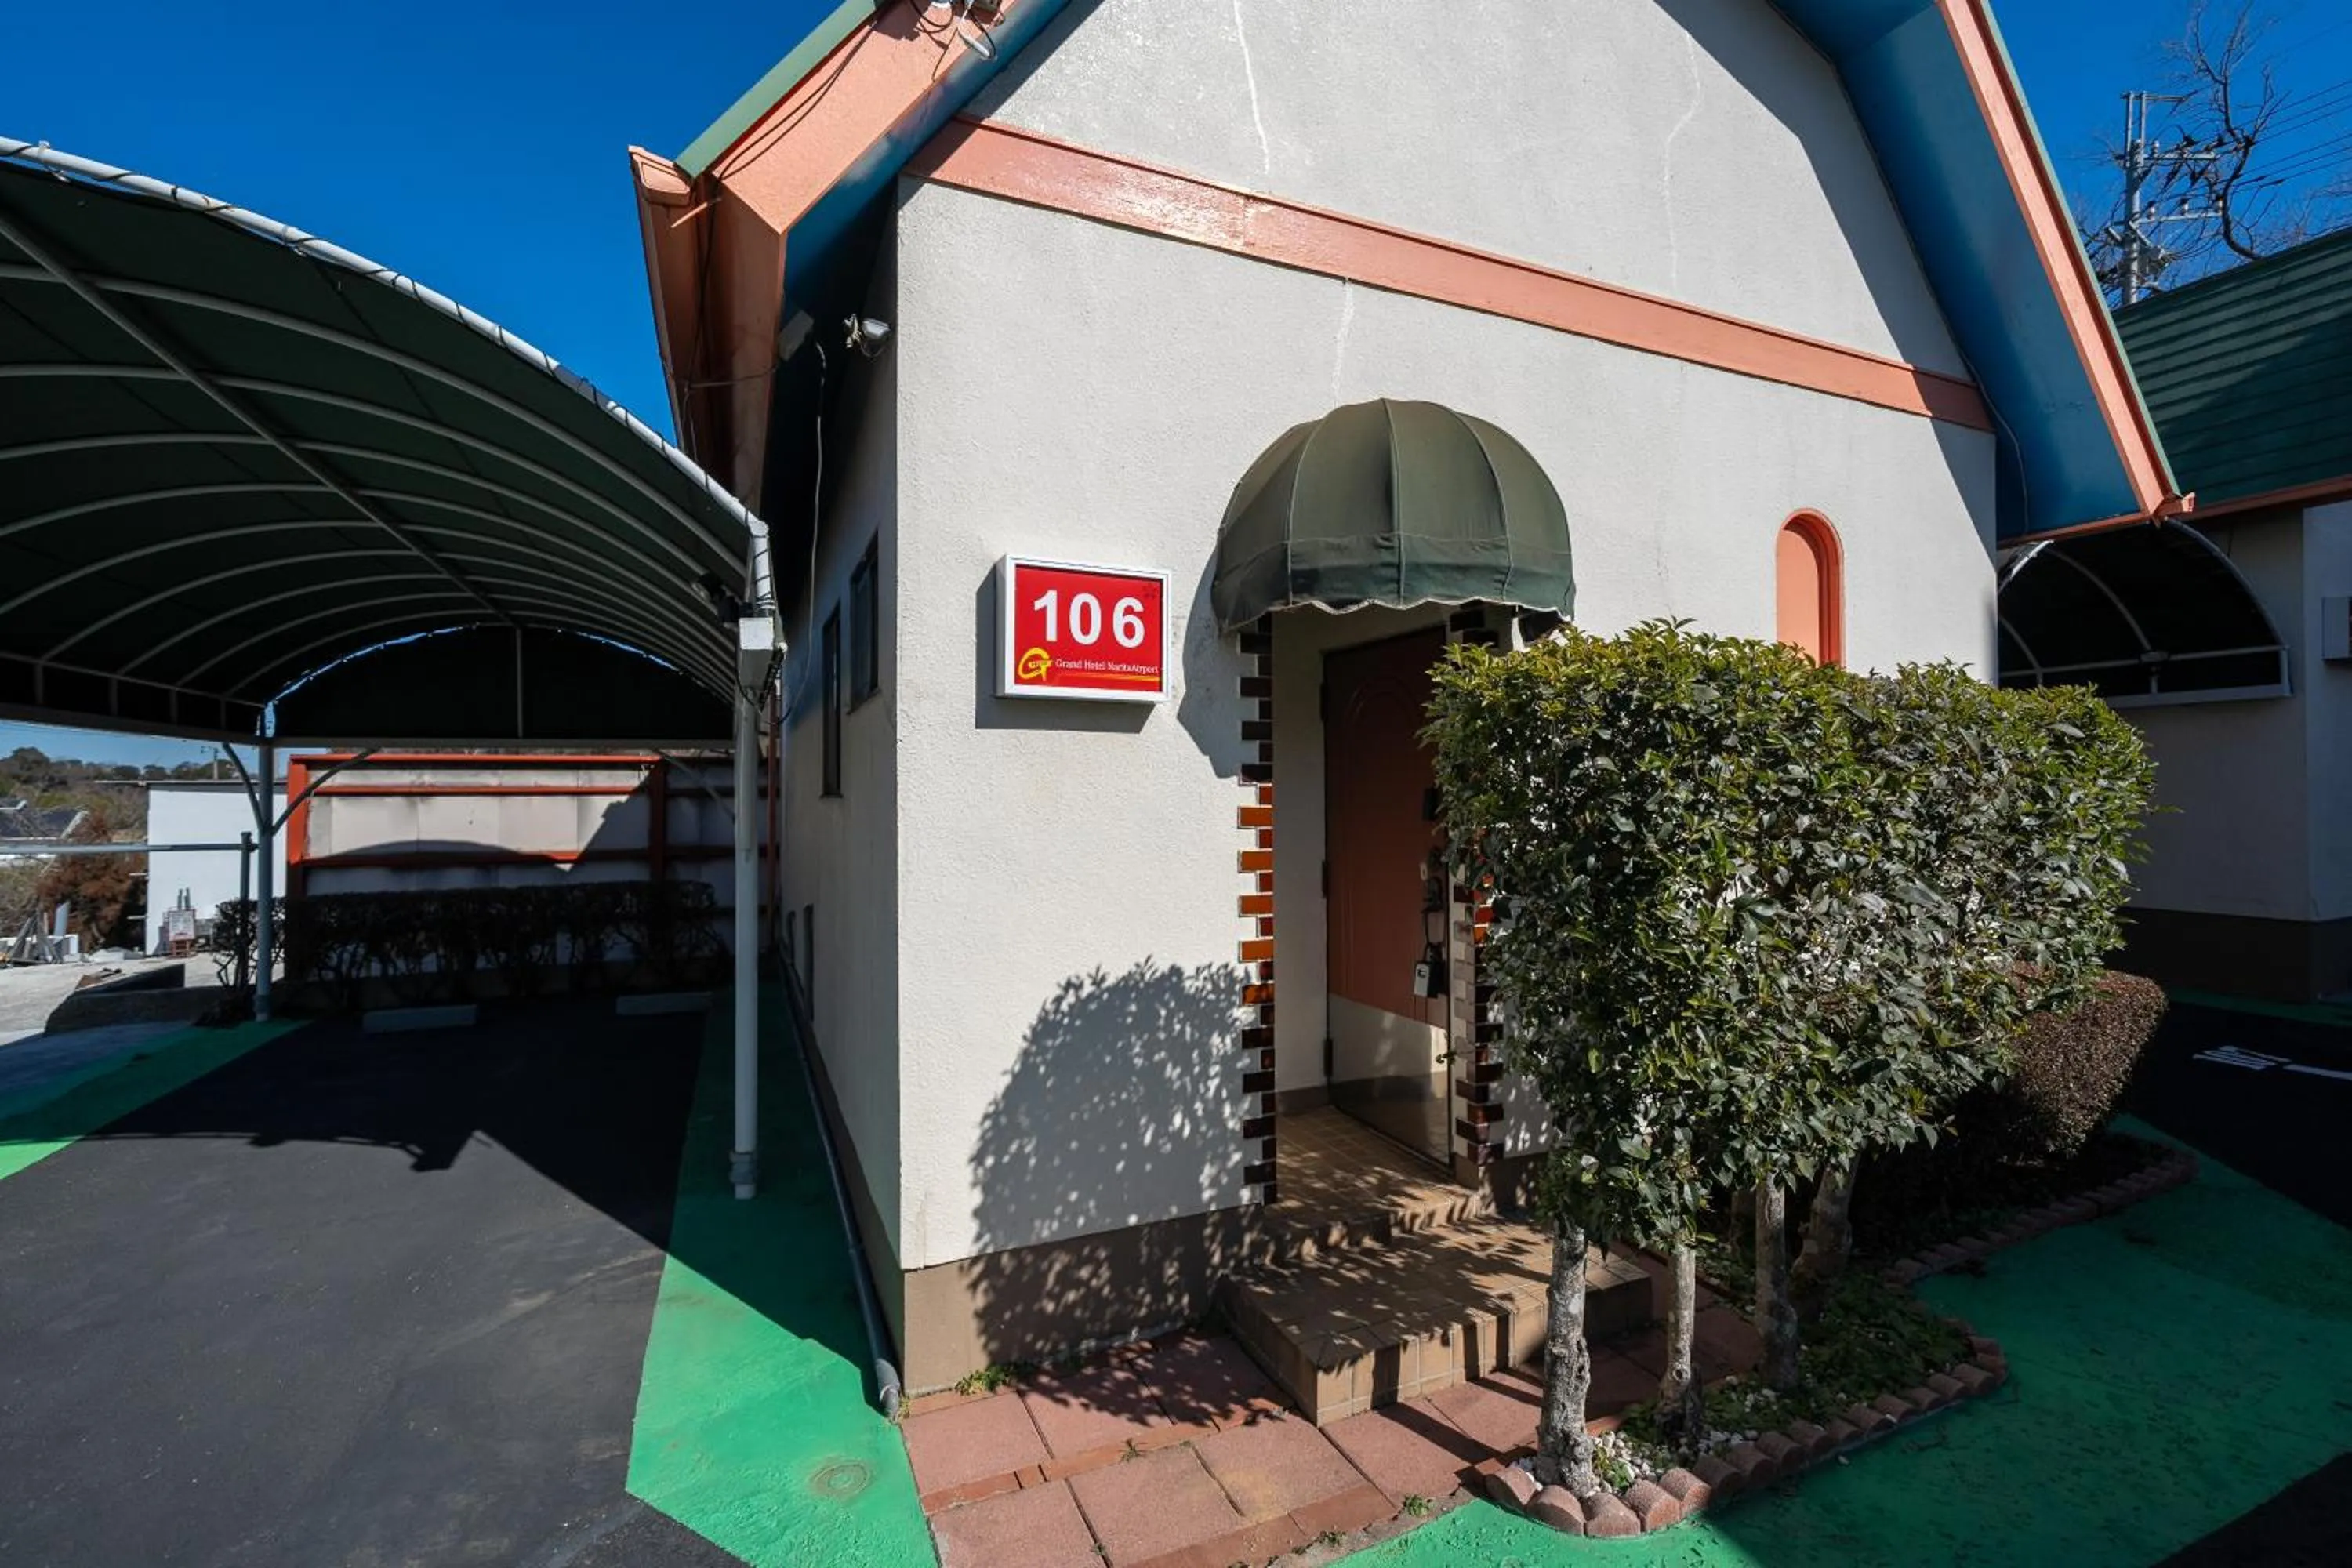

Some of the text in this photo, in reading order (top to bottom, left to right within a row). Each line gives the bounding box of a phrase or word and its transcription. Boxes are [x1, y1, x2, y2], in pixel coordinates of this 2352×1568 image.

[1034, 589, 1145, 648] 106
[1055, 658, 1083, 669] Grand
[1084, 659, 1106, 671] Hotel
